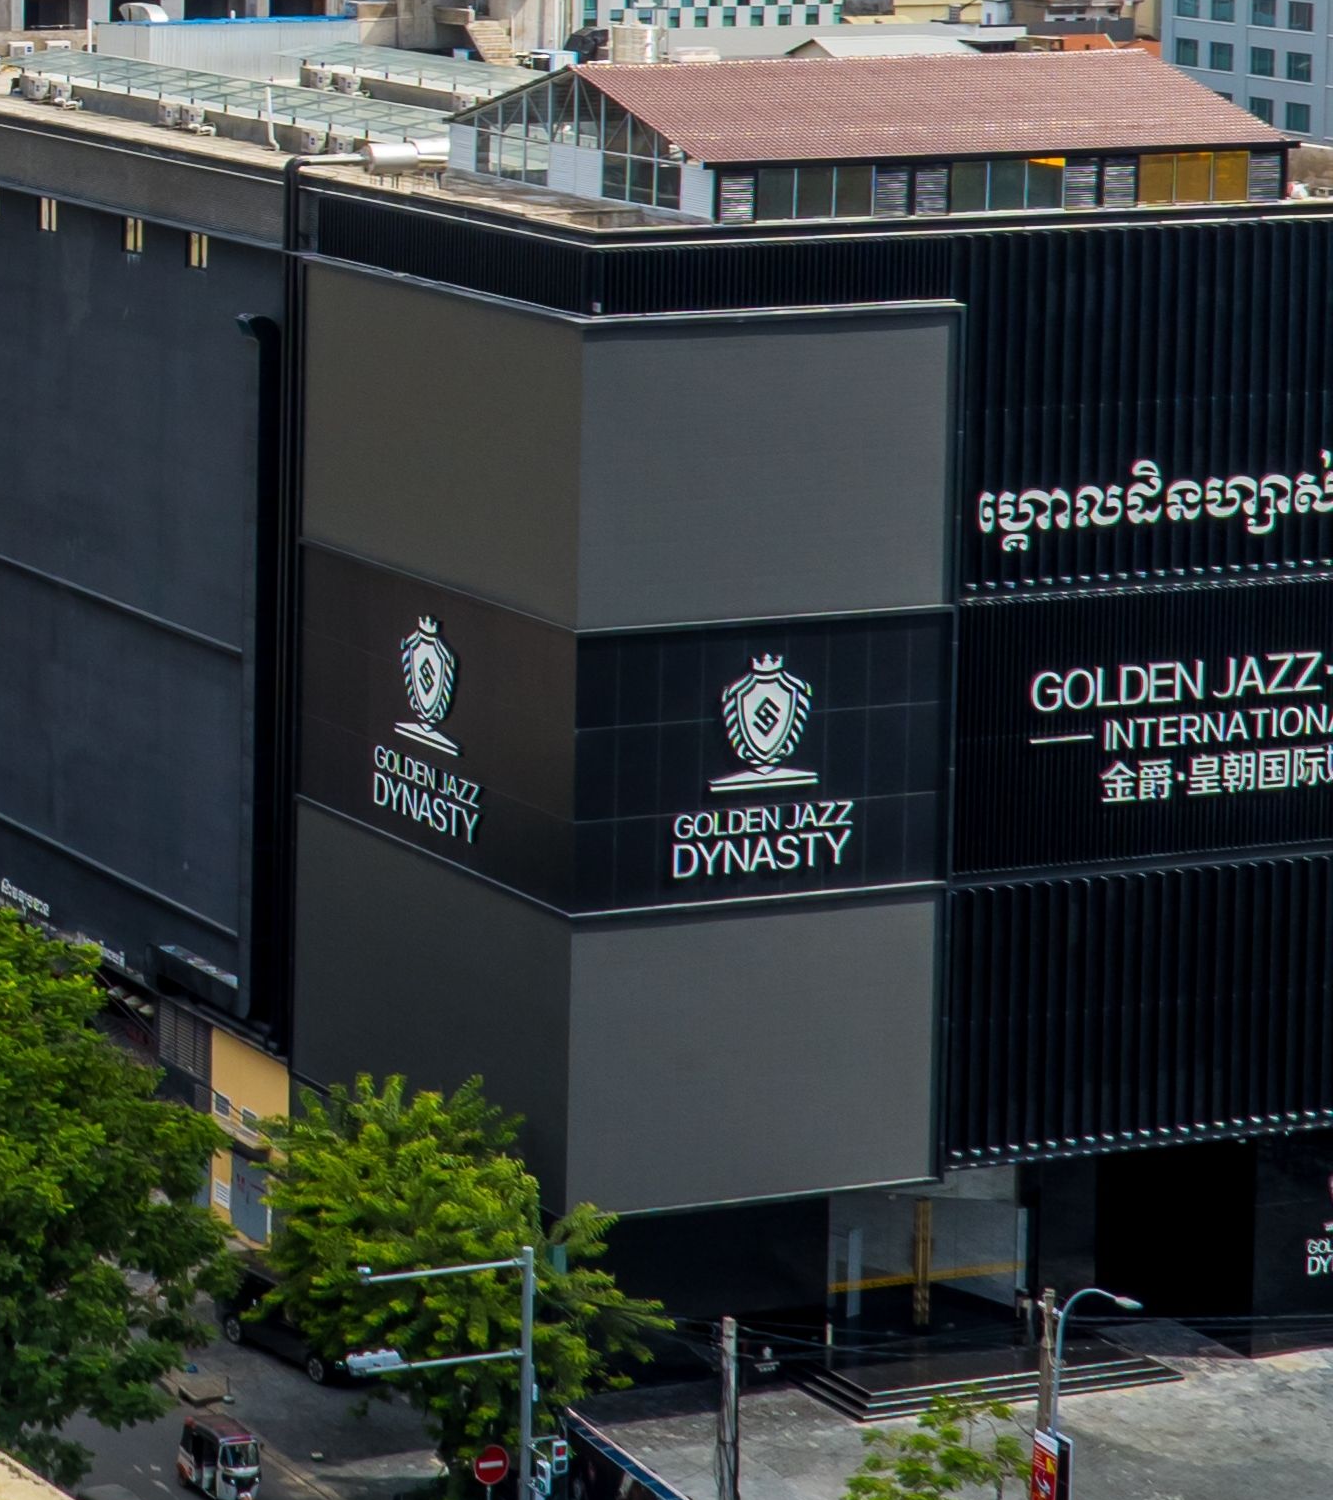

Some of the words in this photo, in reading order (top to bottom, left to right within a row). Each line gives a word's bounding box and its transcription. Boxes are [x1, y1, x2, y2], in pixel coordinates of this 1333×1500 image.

[1030, 659, 1205, 712] GOLDEN
[1212, 651, 1324, 698] JAZZ
[374, 745, 435, 790] GOLDEN
[438, 772, 480, 808] JAZZ
[1099, 744, 1333, 802] 金爵·皇朝国际
[374, 771, 479, 844] DYNASTY
[673, 805, 781, 839] GOLDEN
[785, 801, 854, 830] JAZZ
[672, 829, 852, 879] DYNASTY
